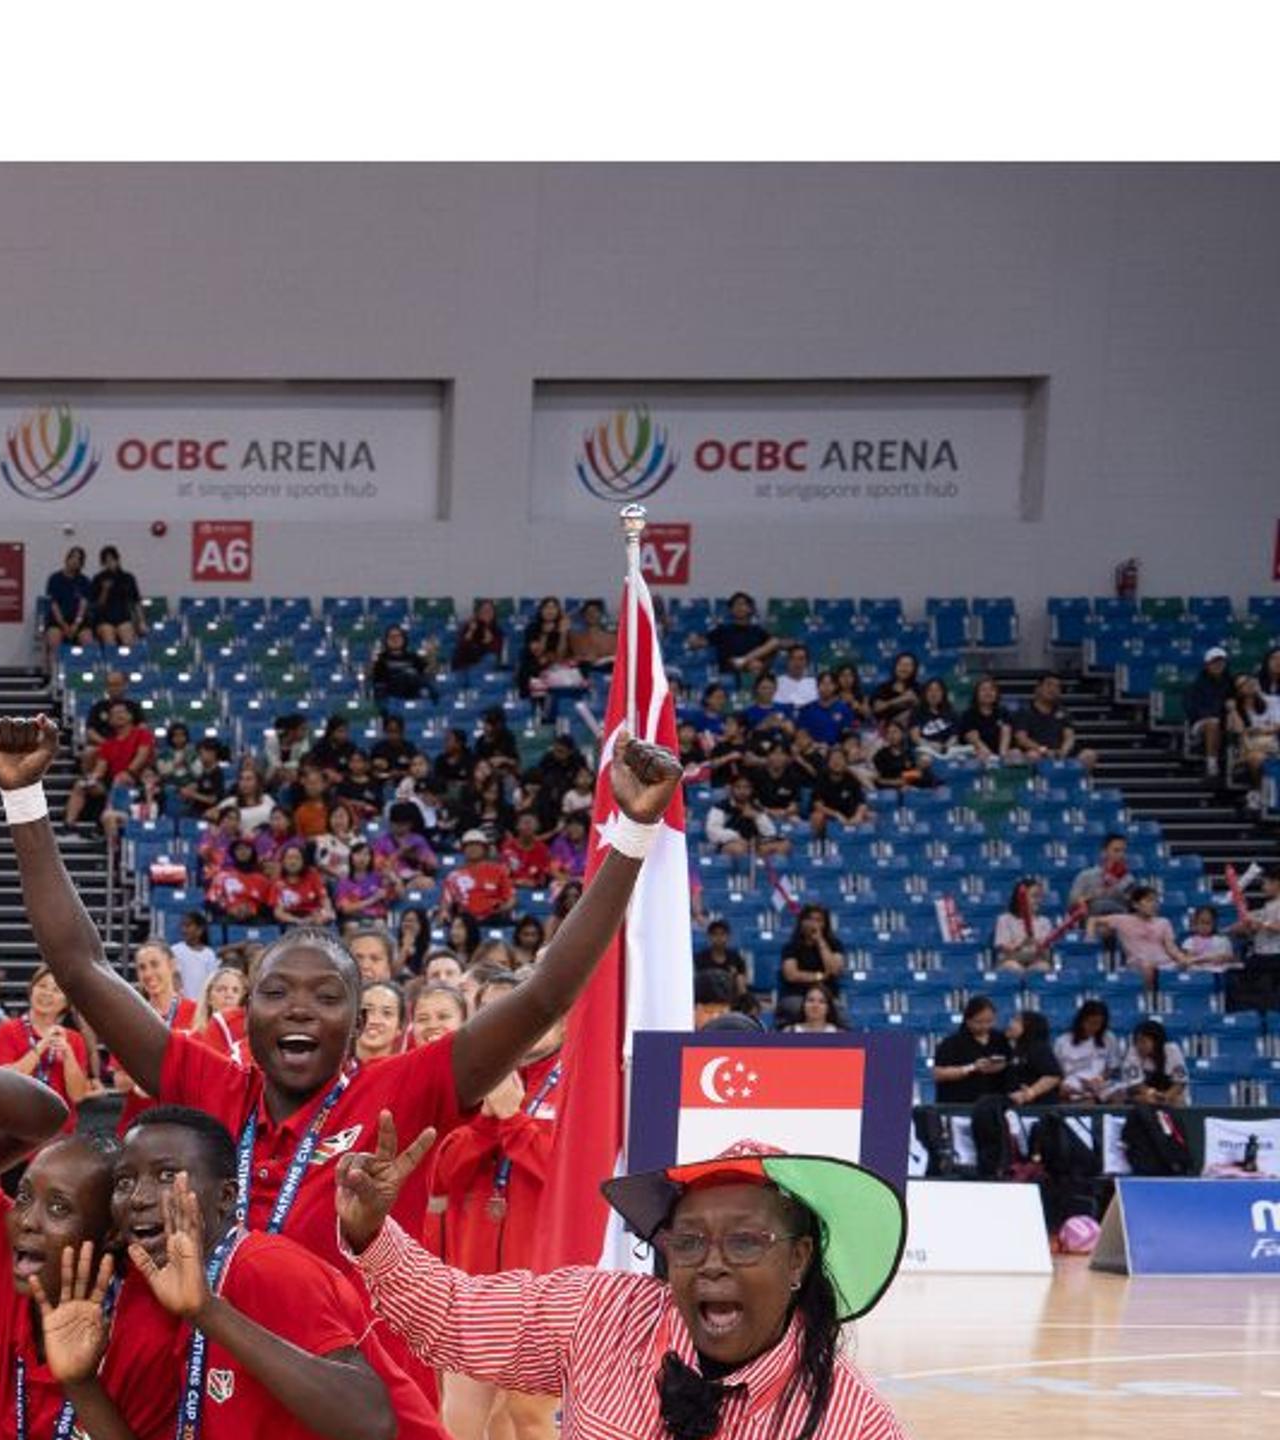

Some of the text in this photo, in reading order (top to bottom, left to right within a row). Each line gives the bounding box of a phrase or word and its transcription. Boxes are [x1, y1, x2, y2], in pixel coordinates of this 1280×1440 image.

[117, 439, 375, 473] OCBC ARENA
[694, 440, 959, 473] OCBC ARENA
[197, 540, 250, 574] A6
[641, 543, 688, 576] A7
[272, 1166, 302, 1224] NATIONS
[296, 1137, 313, 1162] CUP
[190, 1333, 205, 1386] ATIONS
[186, 1391, 199, 1420] CUP
